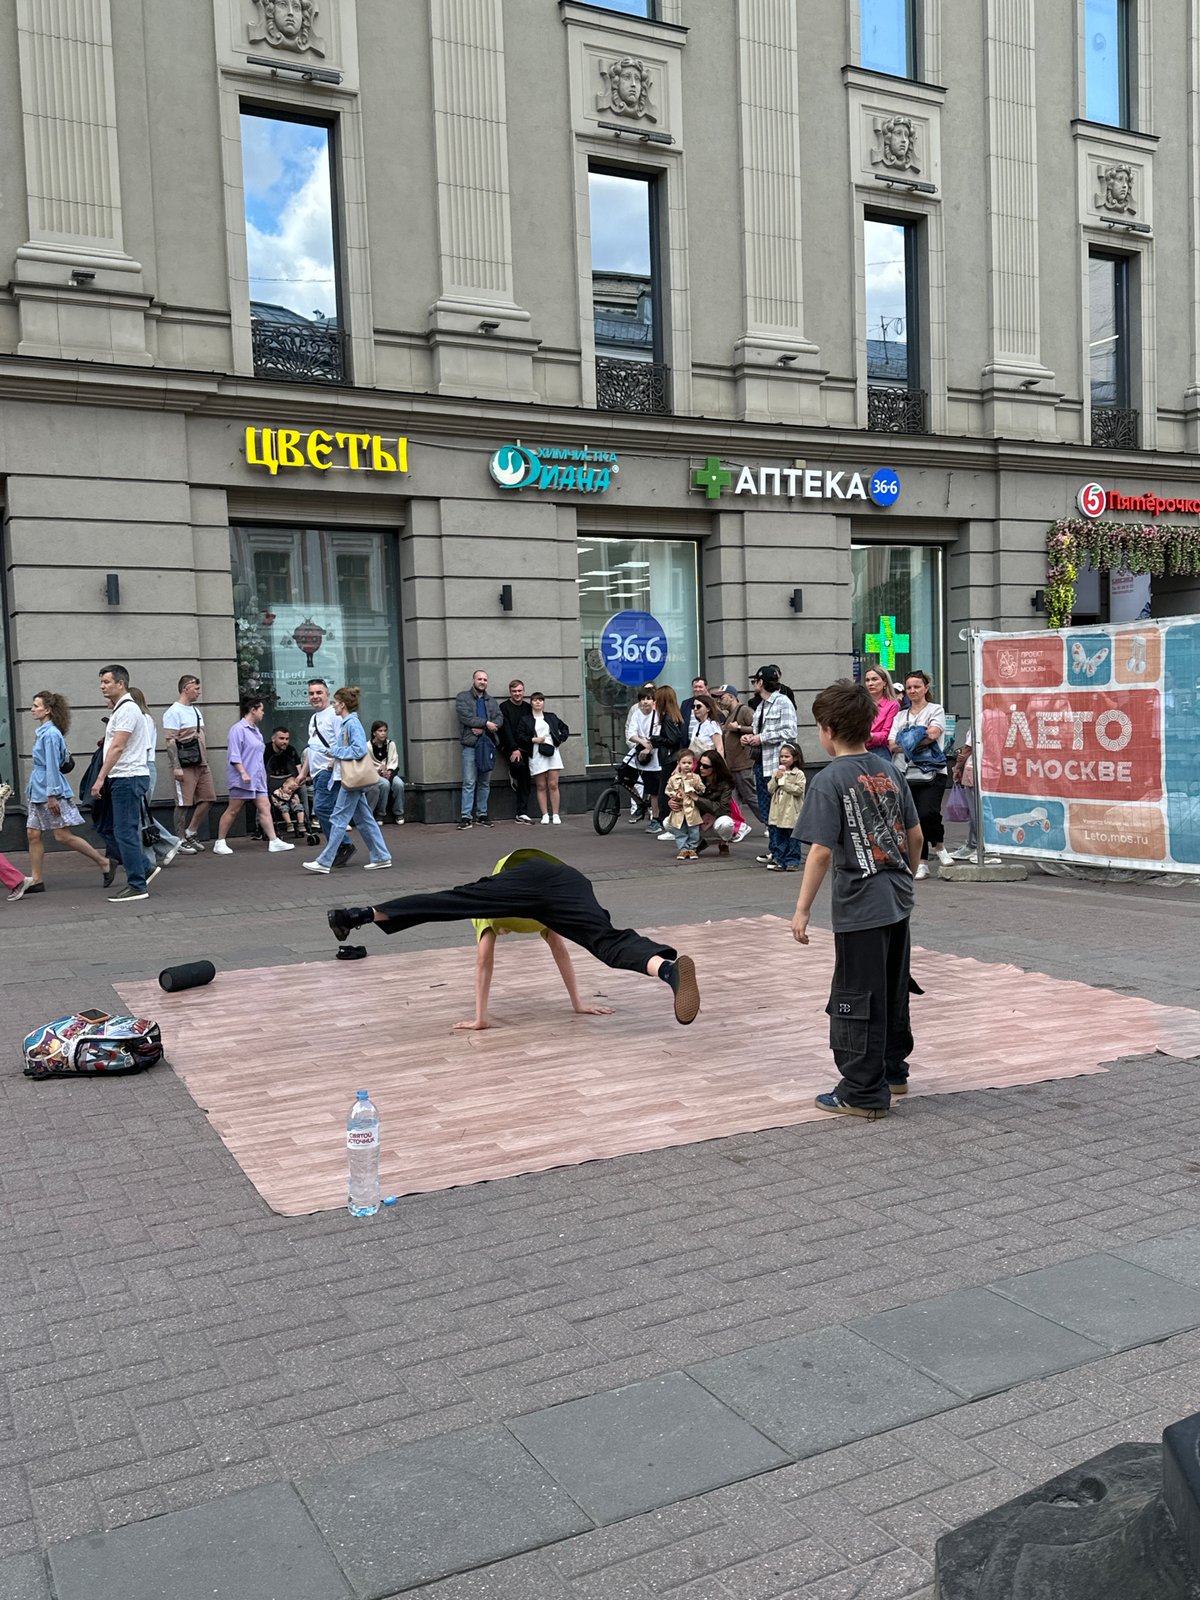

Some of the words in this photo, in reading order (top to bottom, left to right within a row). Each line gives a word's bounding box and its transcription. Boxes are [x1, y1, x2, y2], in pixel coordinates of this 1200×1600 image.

[245, 426, 409, 475] ЦВЕТЫ
[537, 447, 618, 463] ХИМЧИСТКА
[734, 465, 868, 500] АПТЕКА
[1087, 485, 1101, 511] 5
[1004, 704, 1133, 752] ЛЕТО
[1002, 757, 1018, 777] В
[1026, 759, 1132, 783] МОСКВЕ
[843, 794, 856, 827] OPEN
[1084, 830, 1149, 845] Leto.mos.ru
[850, 832, 871, 878] USSIAN
